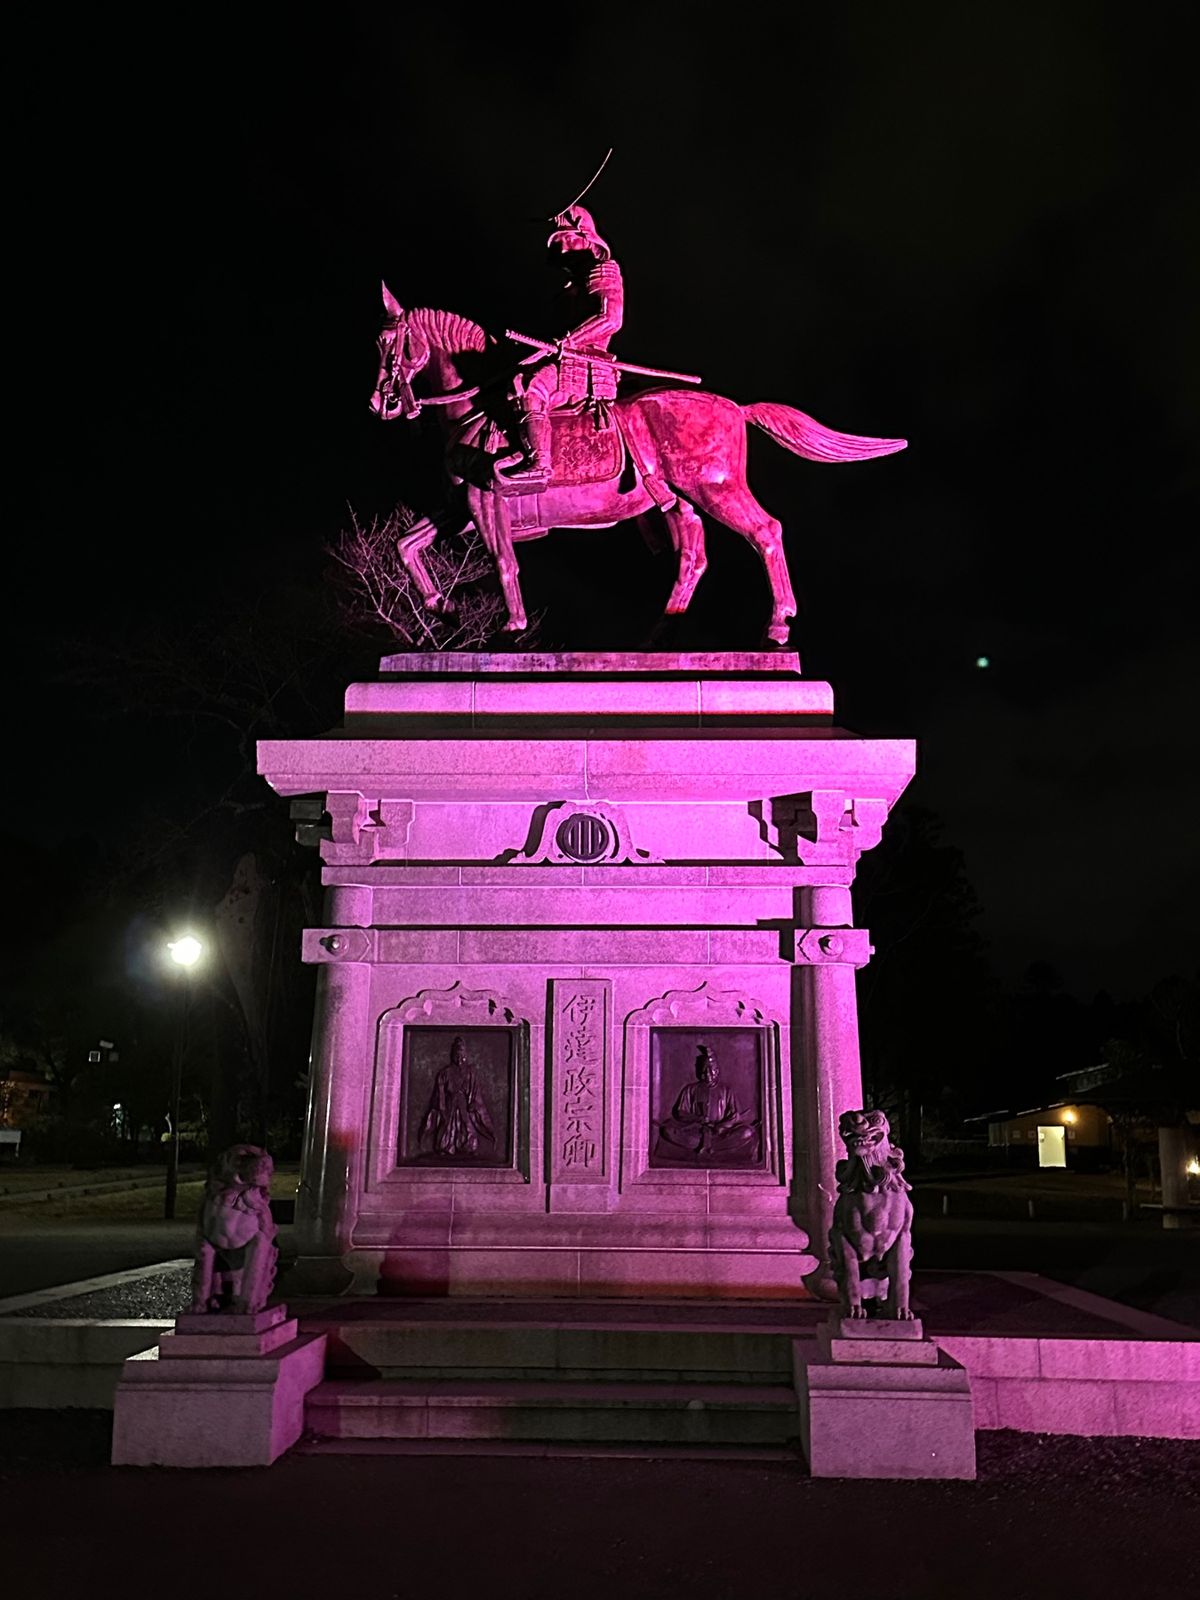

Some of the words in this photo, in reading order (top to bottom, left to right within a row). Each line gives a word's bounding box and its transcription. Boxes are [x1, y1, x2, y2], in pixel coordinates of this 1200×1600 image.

[562, 994, 600, 1168] 伊達政宗卿
